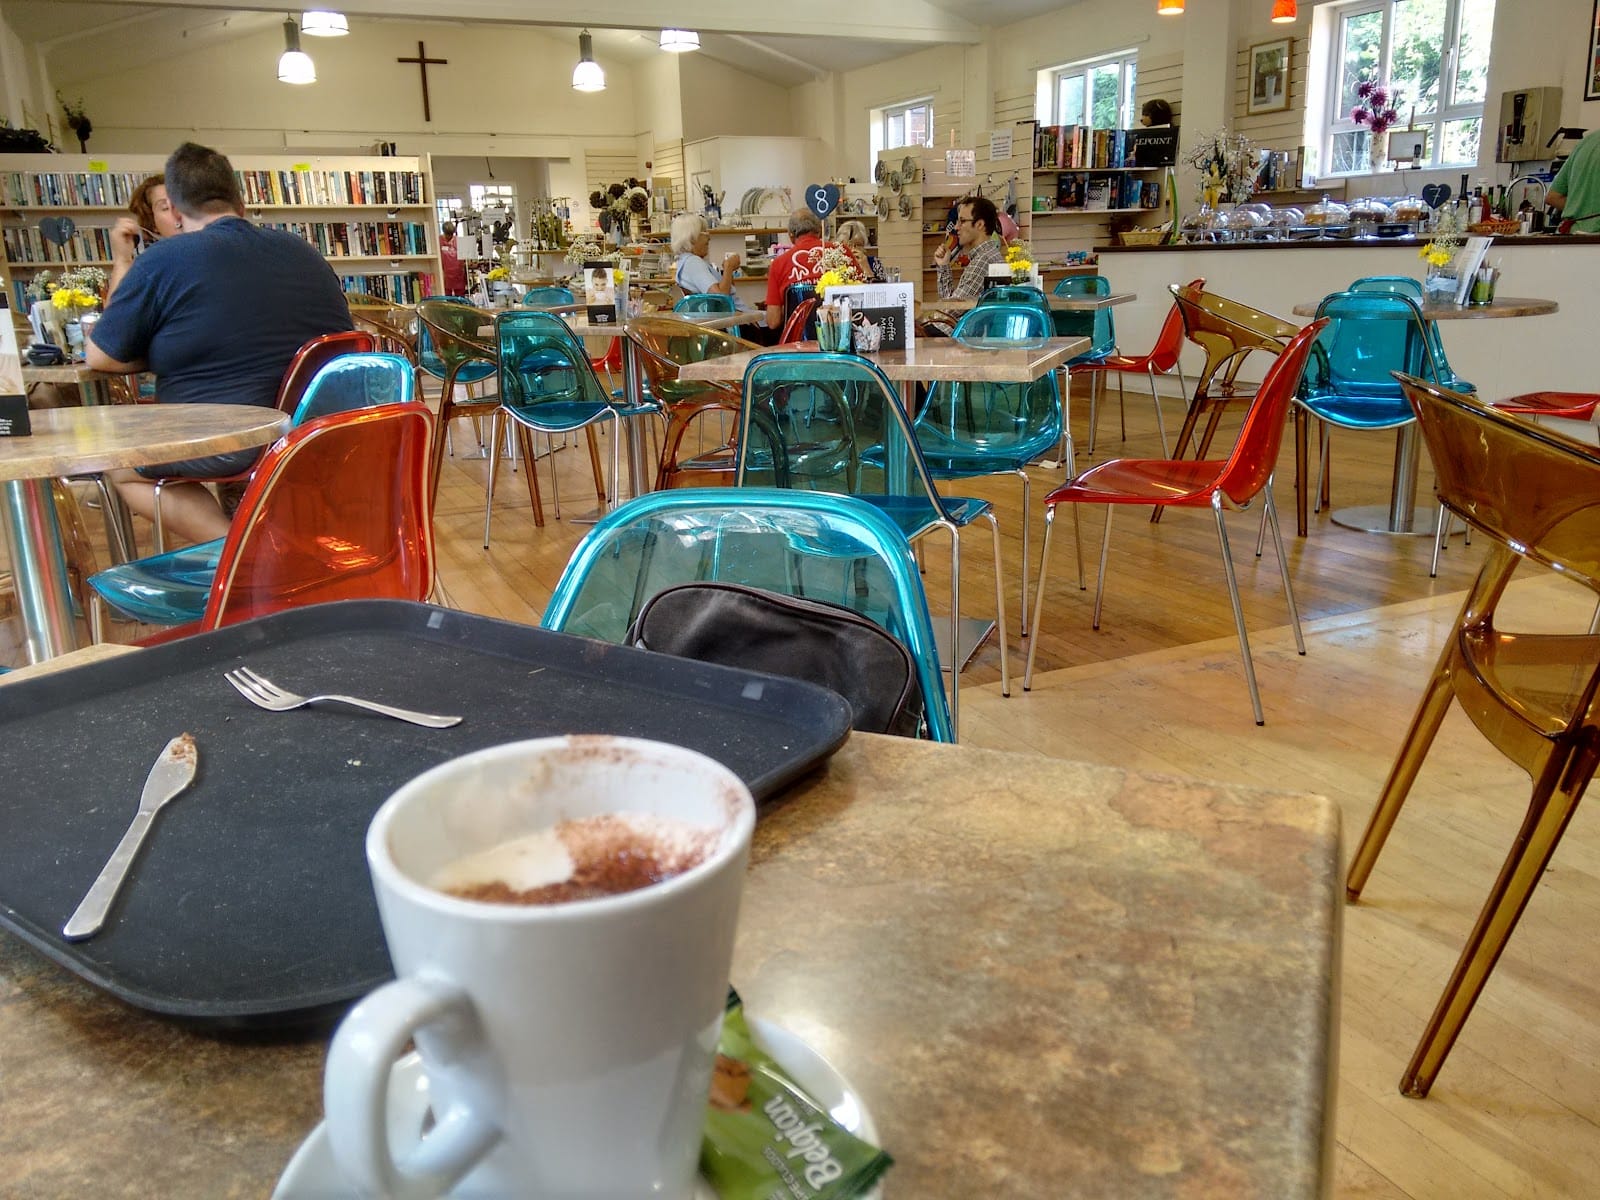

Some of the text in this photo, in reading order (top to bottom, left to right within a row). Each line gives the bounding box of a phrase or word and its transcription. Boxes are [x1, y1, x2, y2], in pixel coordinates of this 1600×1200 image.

[814, 188, 829, 213] 8
[1429, 187, 1442, 206] 7
[887, 316, 897, 341] Coffee
[763, 1095, 843, 1191] Belgian
